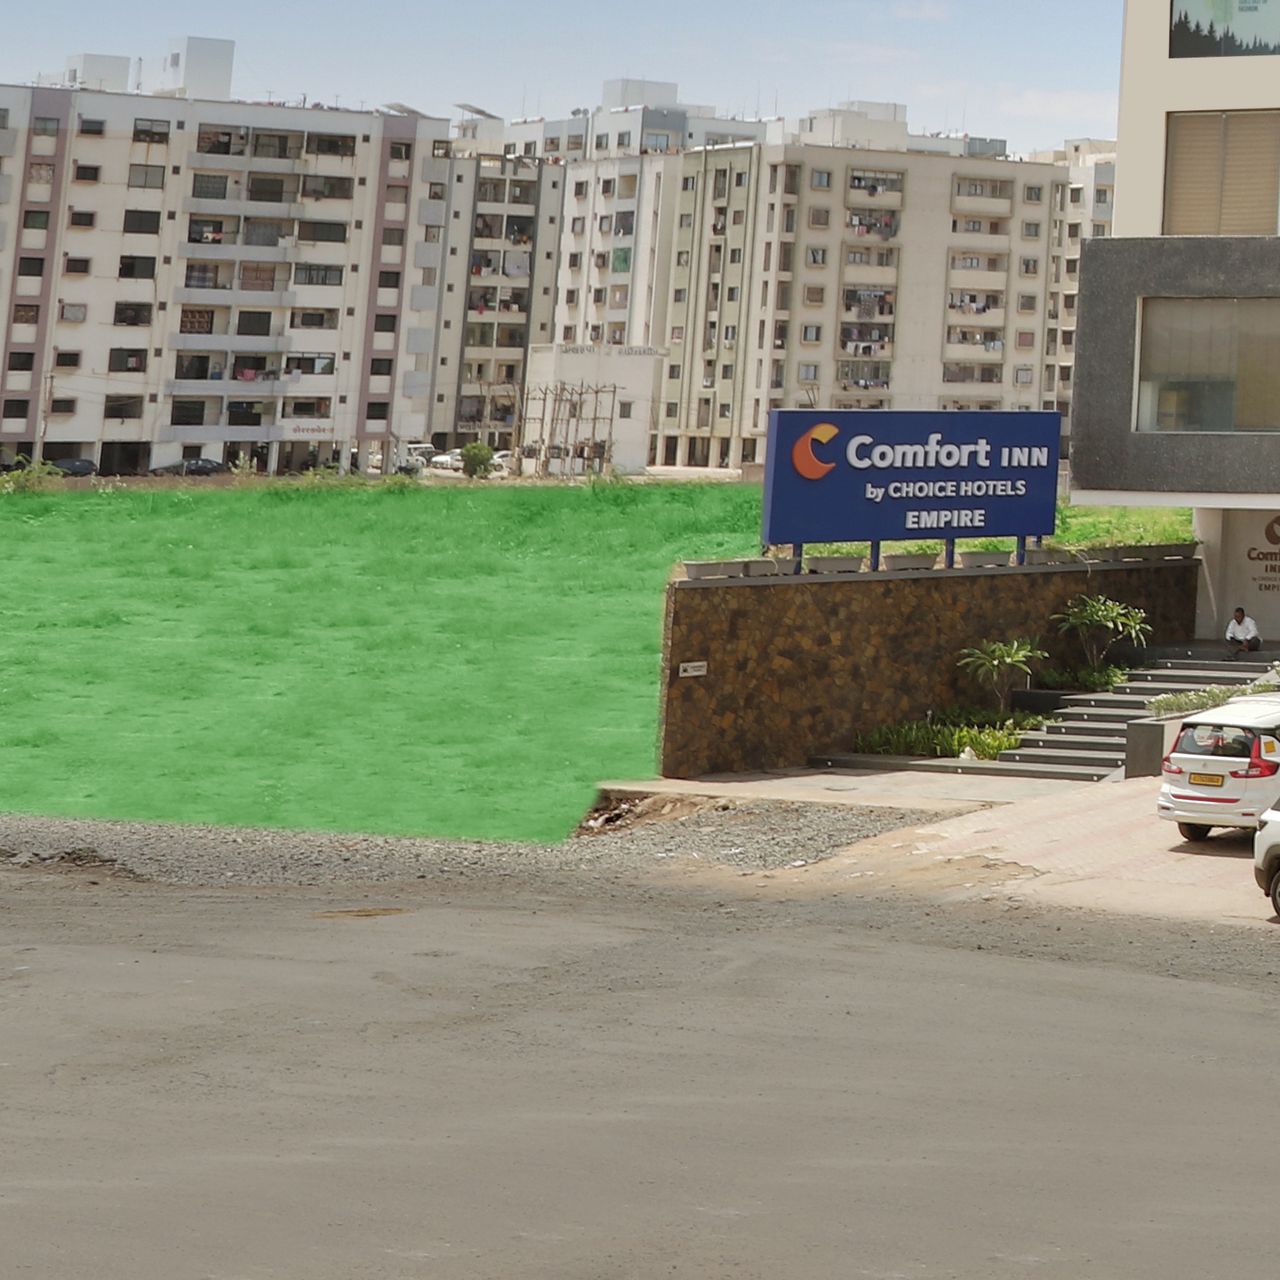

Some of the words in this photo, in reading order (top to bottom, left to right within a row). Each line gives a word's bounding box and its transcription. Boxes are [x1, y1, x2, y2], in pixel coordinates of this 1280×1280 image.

[846, 433, 991, 470] Comfort
[1000, 447, 1049, 467] INN
[865, 483, 886, 502] by
[887, 481, 957, 499] CHOICE
[959, 480, 1027, 497] HOTELS
[905, 509, 986, 529] EMPIRE
